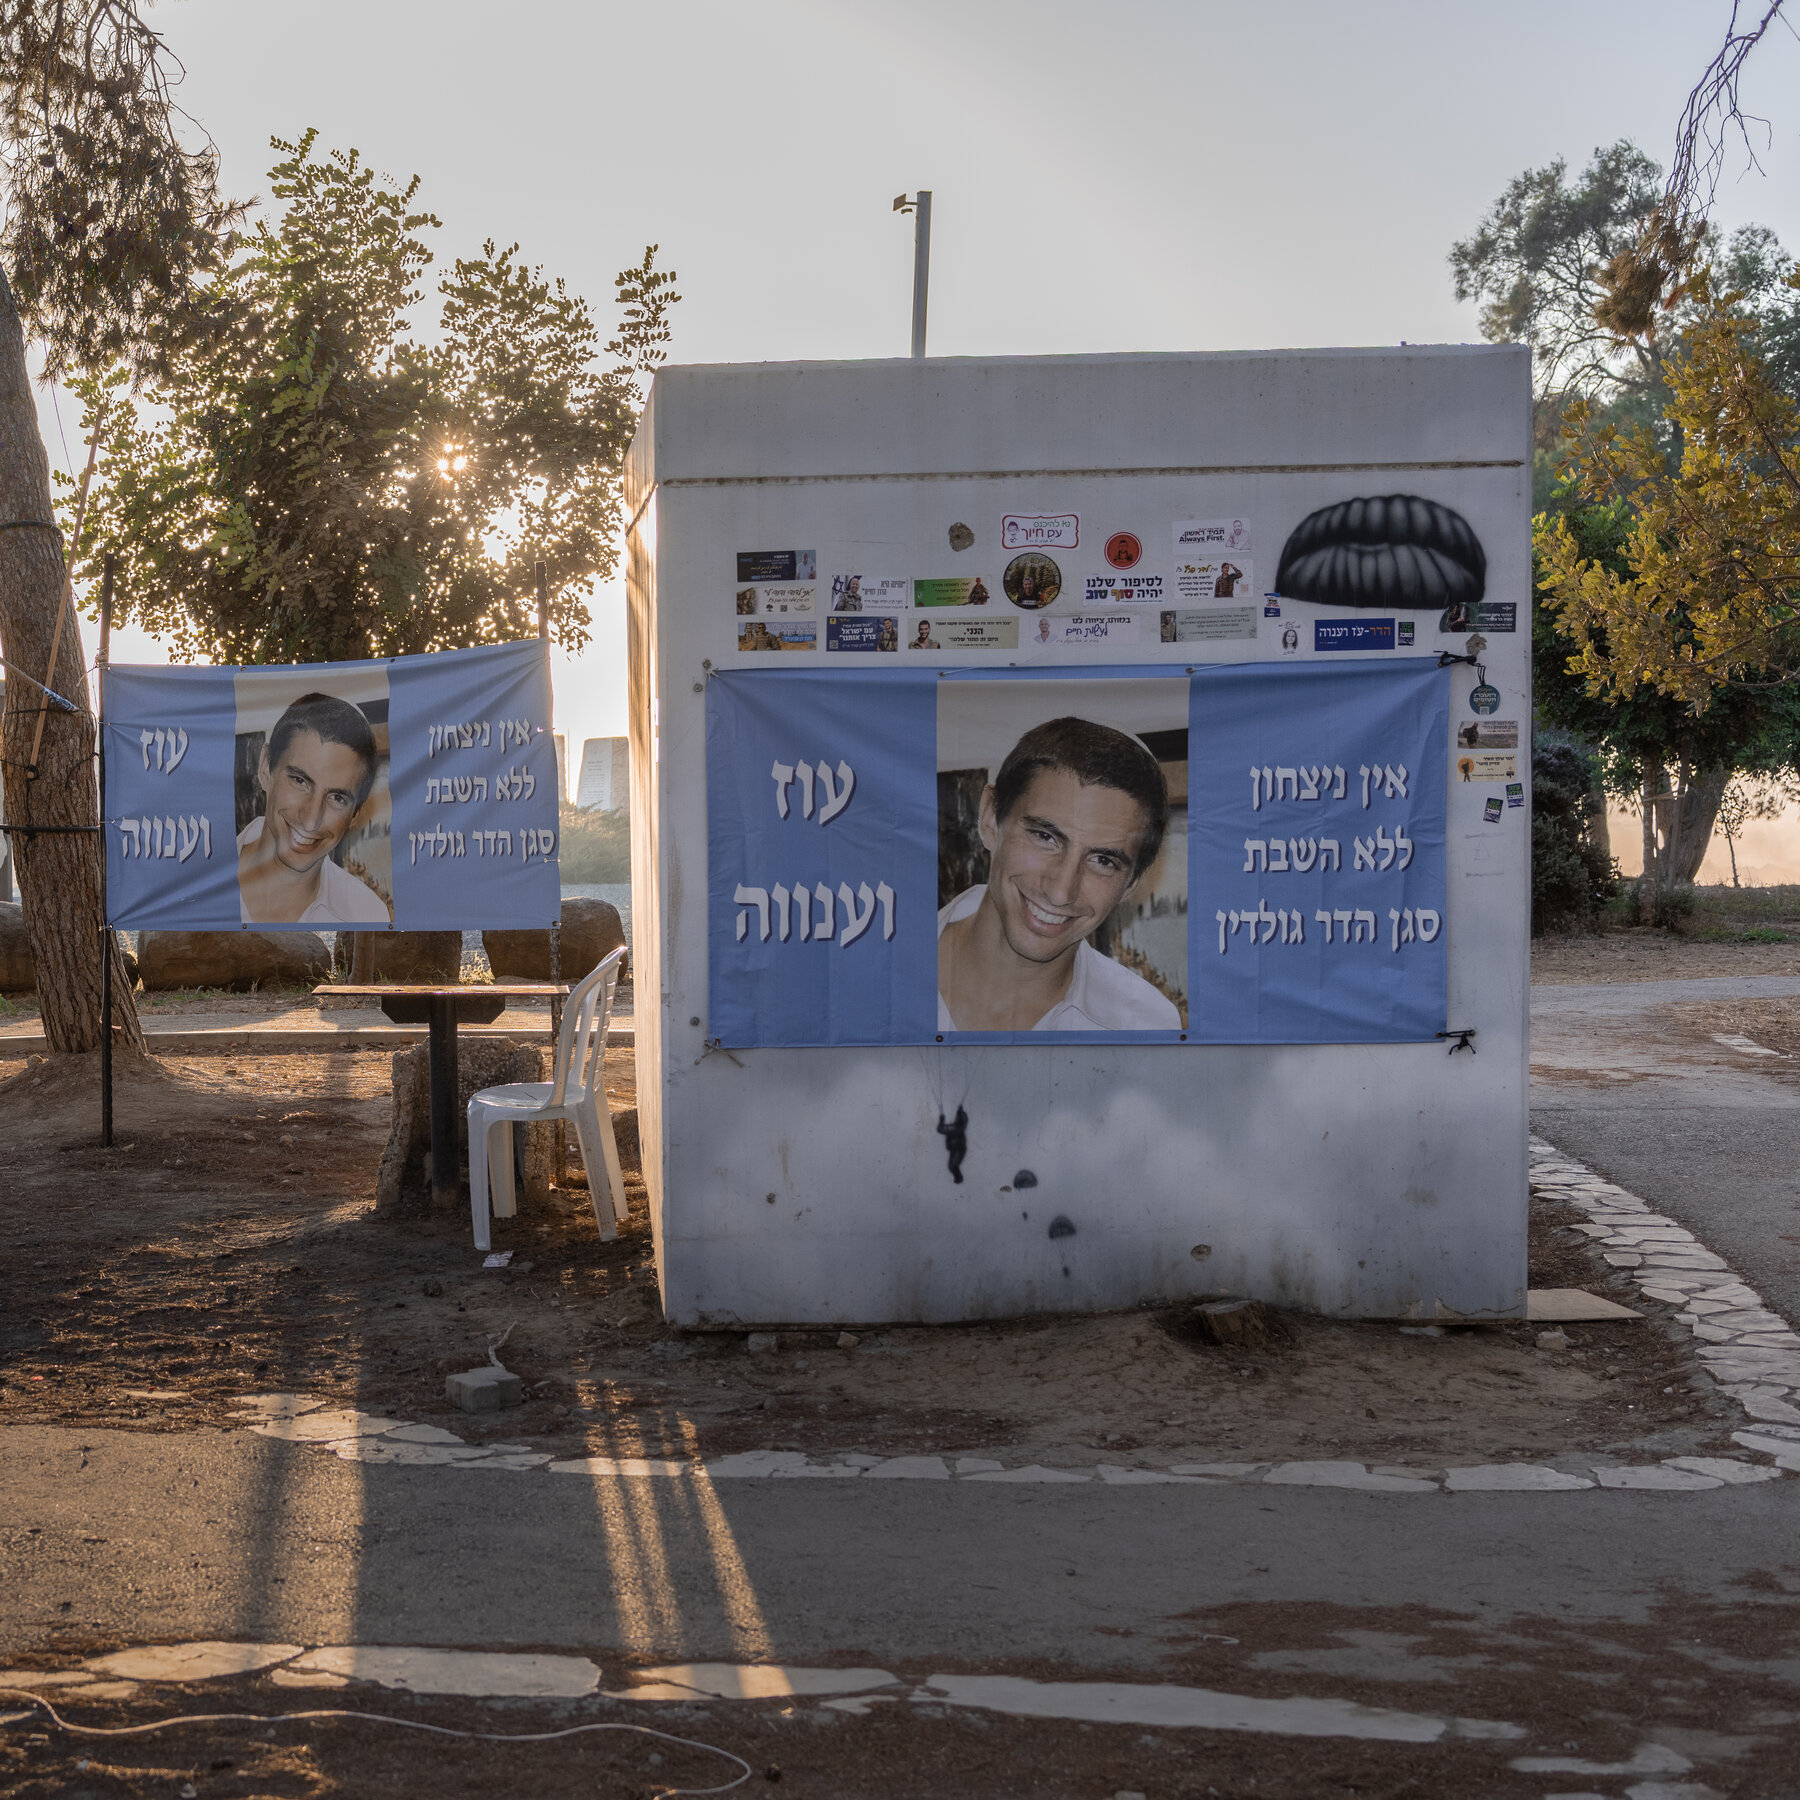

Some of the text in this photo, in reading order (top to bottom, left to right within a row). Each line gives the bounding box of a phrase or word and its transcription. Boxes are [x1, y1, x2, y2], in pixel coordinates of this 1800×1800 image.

[1033, 519, 1071, 528] נא להיכנס
[1021, 528, 1044, 541] חיוך
[1047, 529, 1062, 538] עם
[1179, 535, 1205, 543] Always
[1086, 576, 1163, 588] לסיפור שלנו
[1086, 589, 1163, 602] יהיה סוף טוב
[841, 627, 863, 635] ישראל
[861, 633, 876, 642] צריך
[963, 627, 984, 635] הנני.
[1066, 621, 1108, 638] לעשות חיים
[1319, 627, 1349, 638] וענוה
[427, 718, 532, 759] אין ניצחון
[139, 728, 189, 775] עוז
[424, 764, 536, 805] ללא השבת
[771, 760, 855, 826] עוז
[1250, 764, 1408, 810] אין ניצחון
[119, 815, 212, 864] וענווה
[408, 822, 556, 866] סגן הדר גולדין
[1243, 825, 1414, 873] ללא השבת
[732, 880, 896, 948] וענווה
[1215, 898, 1441, 954] סגן הדר גולדין
